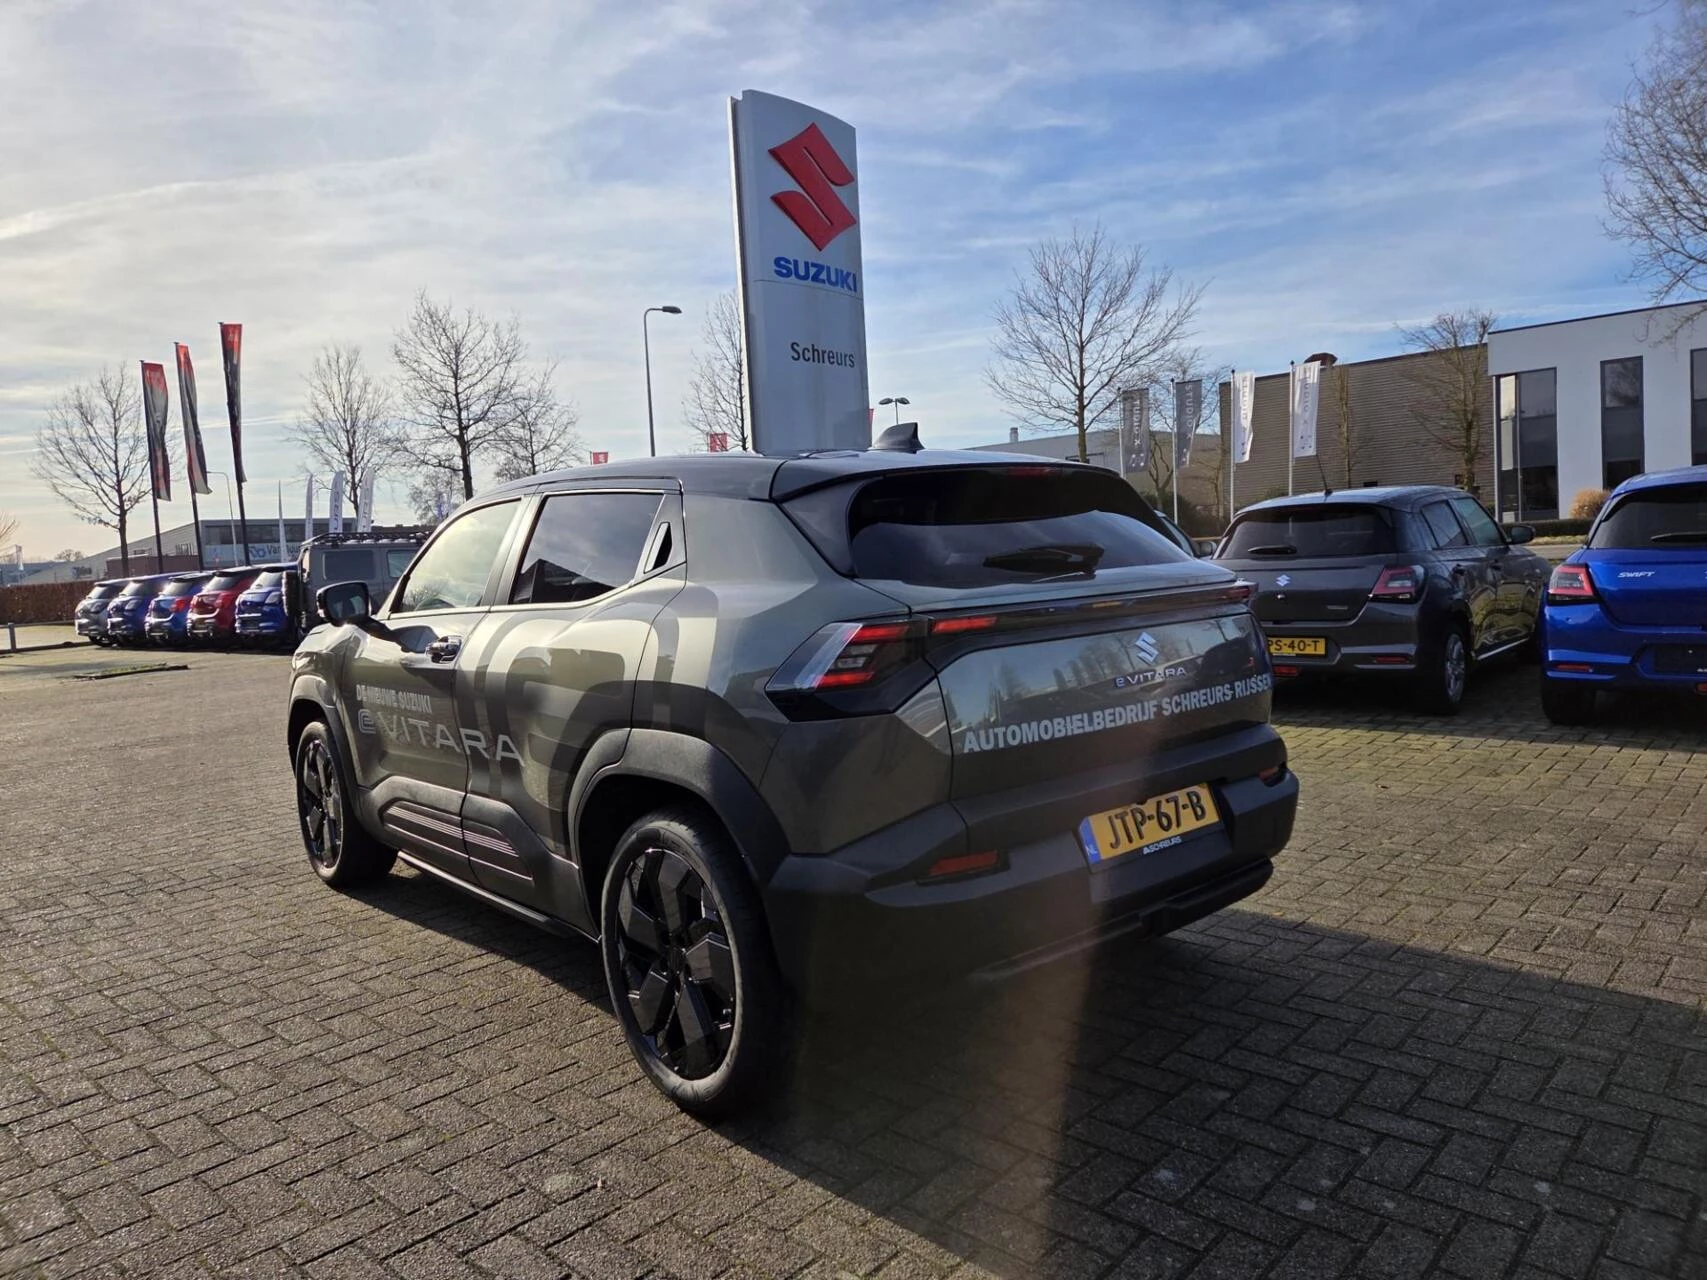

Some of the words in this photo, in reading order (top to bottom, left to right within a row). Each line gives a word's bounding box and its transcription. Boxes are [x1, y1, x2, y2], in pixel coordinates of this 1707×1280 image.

[773, 256, 857, 292] SUZUKI
[791, 342, 855, 368] Schreurs
[1185, 384, 1194, 428] STUDIO
[398, 691, 433, 714] SUZUKI
[963, 702, 1158, 754] AUTOMOBIELBEDRIJF
[1161, 684, 1232, 716] SCHREURS
[377, 712, 525, 767] VITARA
[1108, 791, 1206, 849] JTP-67-B
